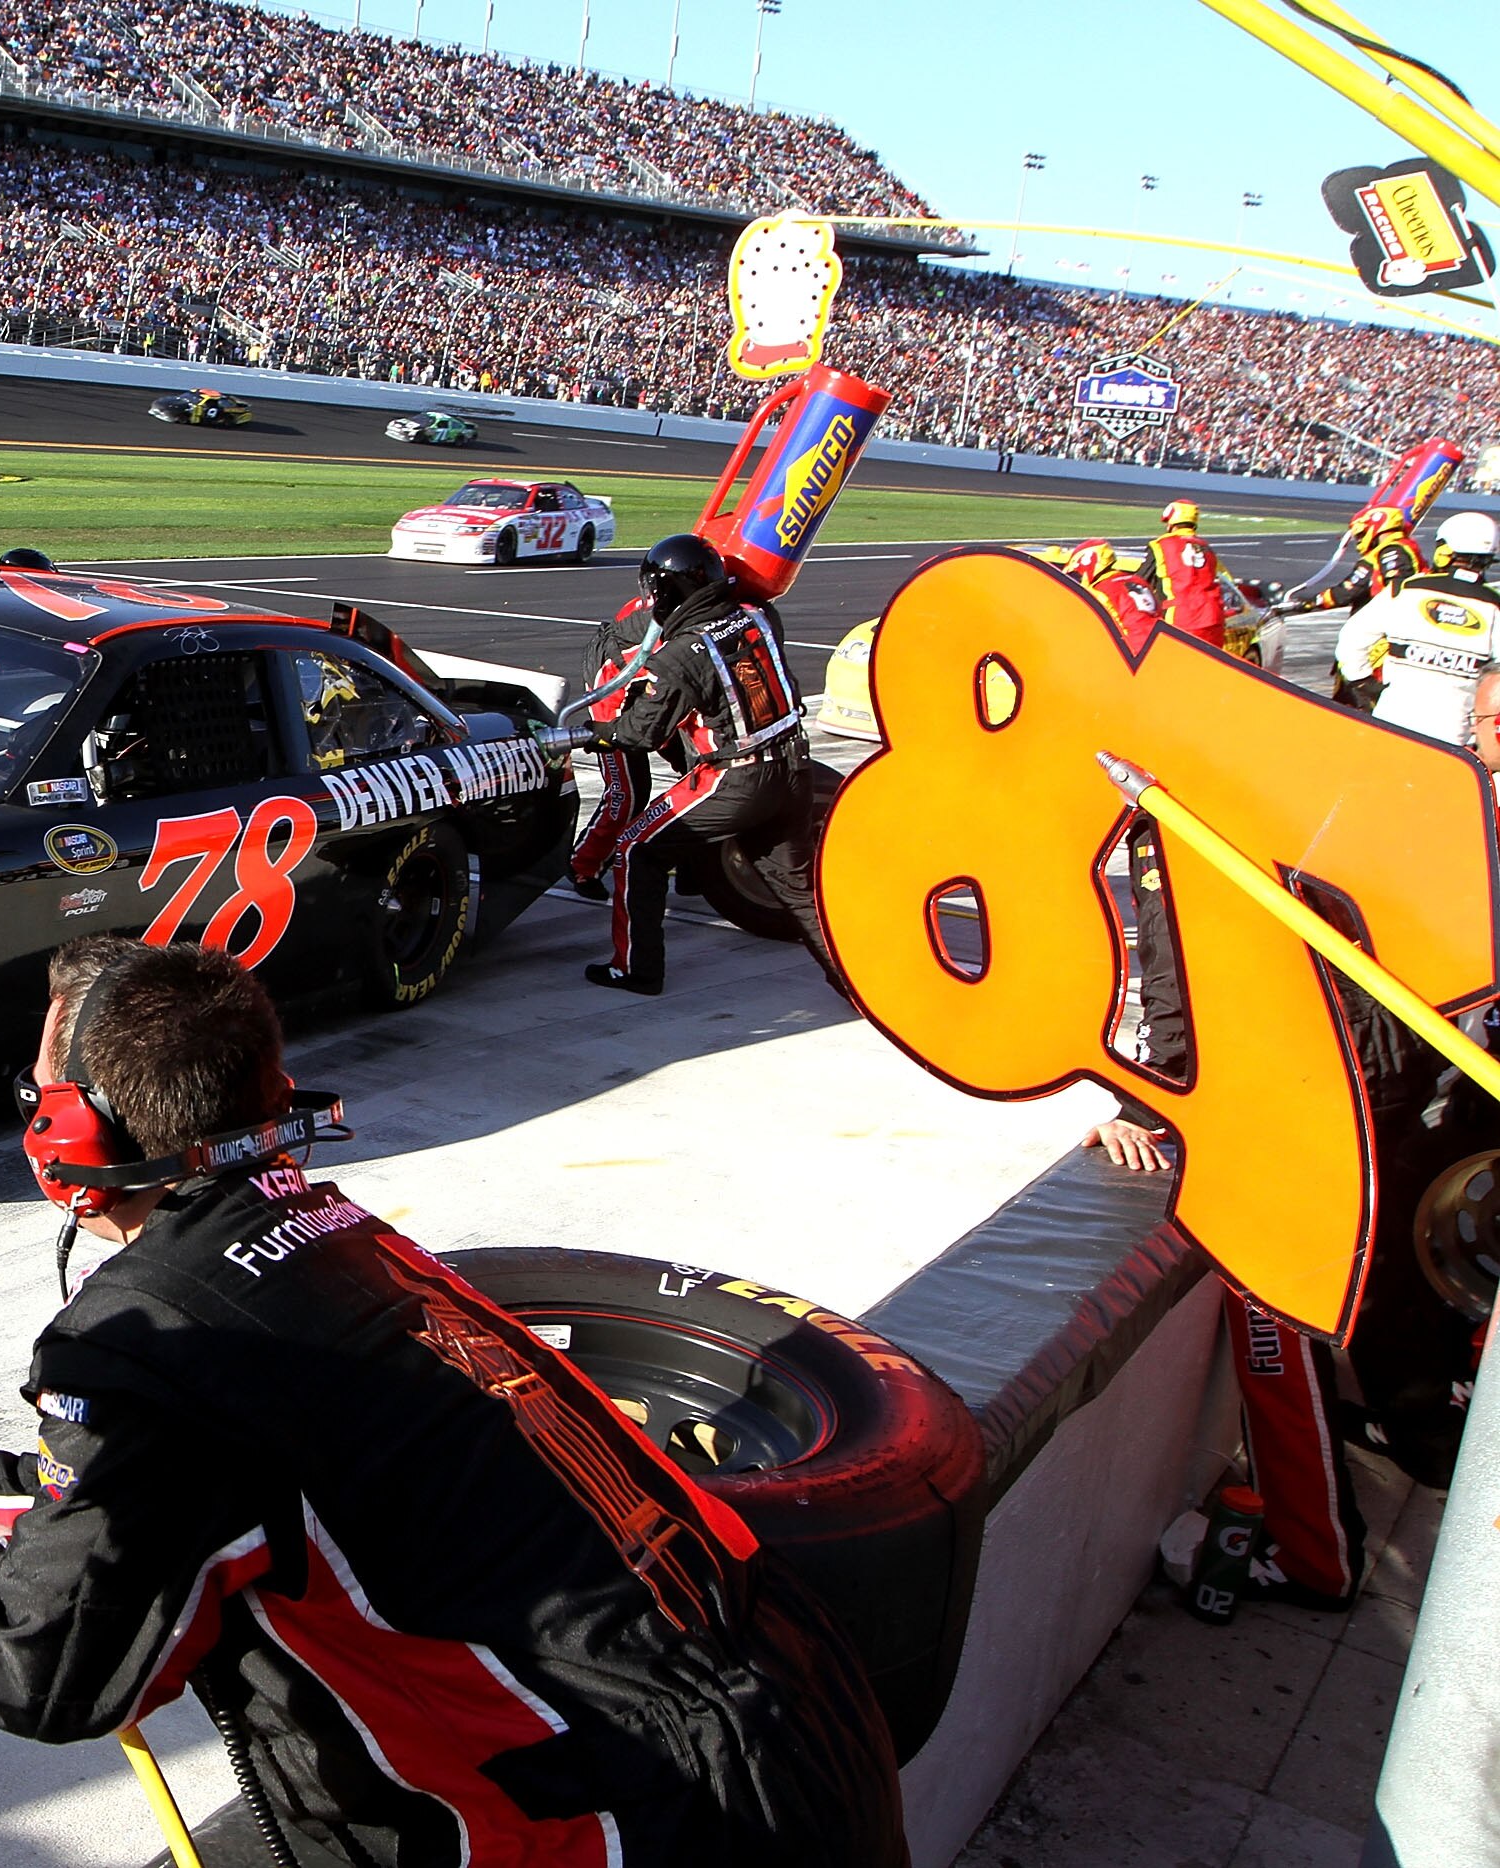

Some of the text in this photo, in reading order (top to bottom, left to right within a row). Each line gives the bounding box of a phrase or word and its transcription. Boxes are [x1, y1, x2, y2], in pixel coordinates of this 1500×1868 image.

[1363, 193, 1404, 256] RACING
[1391, 185, 1435, 258] Cheerios
[1101, 357, 1161, 377] TEAM
[1088, 408, 1159, 420] RACING
[780, 420, 854, 546] SUNOCO
[536, 516, 567, 550] 32
[1405, 644, 1479, 674] OFFICIAL
[50, 781, 79, 792] NASCAR
[320, 737, 546, 832] DENVER MATTRESS
[644, 796, 673, 824] Row
[64, 833, 89, 847] NASCAR
[71, 844, 96, 860] Sprint
[386, 826, 430, 887] EAGLE
[137, 795, 318, 972] 78
[65, 904, 100, 917] POLE
[208, 1119, 306, 1167] RACING ELECTRONICS
[658, 1272, 704, 1299] LF
[716, 1279, 924, 1378] EAGLE
[1218, 1526, 1253, 1557] G
[1196, 1583, 1235, 1616] 02
